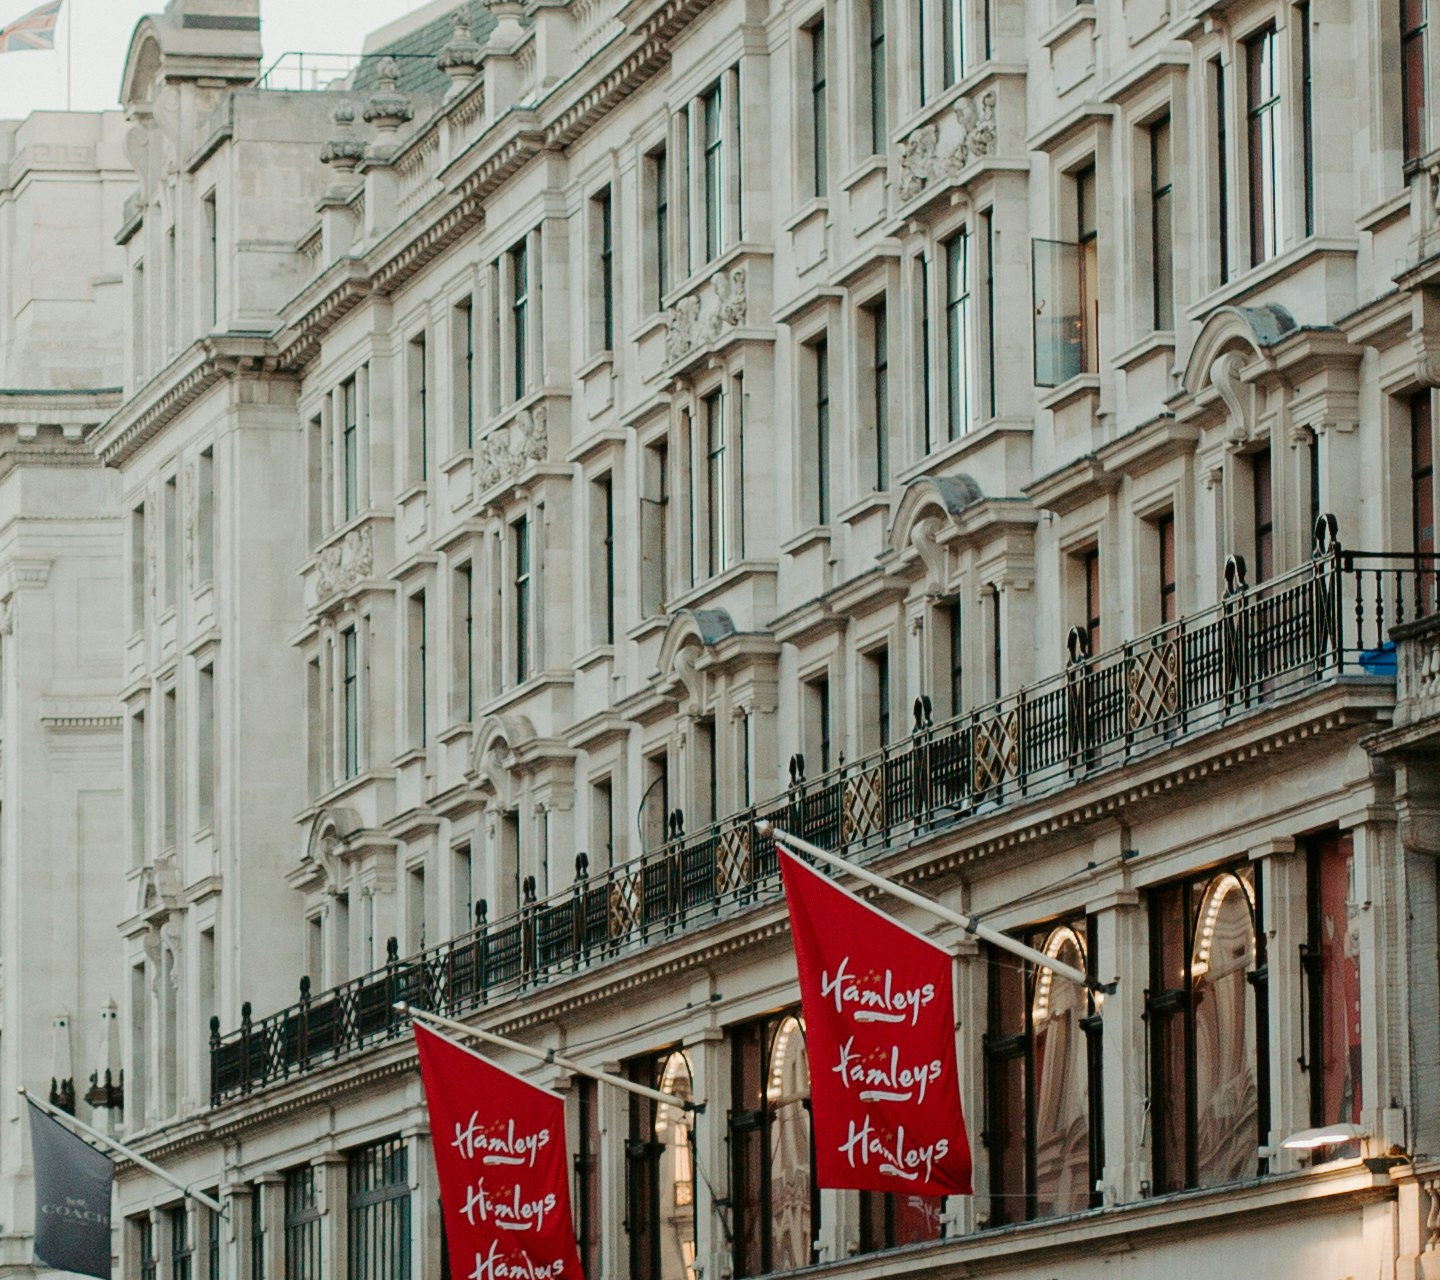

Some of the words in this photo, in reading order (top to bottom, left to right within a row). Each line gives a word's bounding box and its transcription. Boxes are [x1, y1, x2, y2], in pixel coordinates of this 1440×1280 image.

[821, 956, 935, 1027] Hamleys
[832, 1035, 942, 1105] Hamleys
[451, 1110, 550, 1168] Hamleys
[838, 1114, 949, 1184] Hamleys
[459, 1176, 556, 1232] Hamleys
